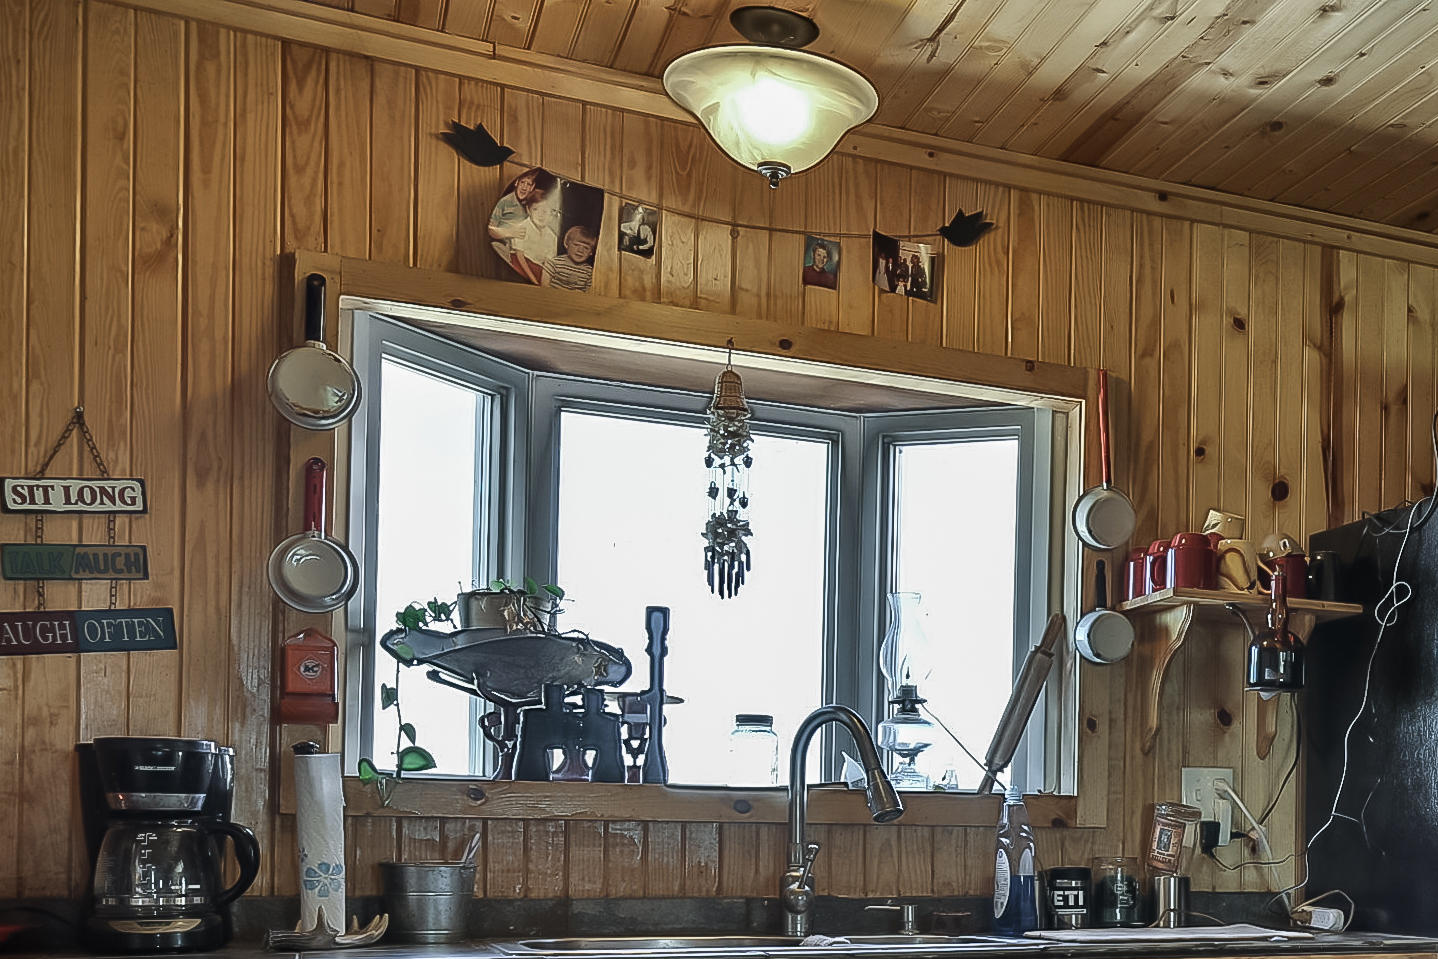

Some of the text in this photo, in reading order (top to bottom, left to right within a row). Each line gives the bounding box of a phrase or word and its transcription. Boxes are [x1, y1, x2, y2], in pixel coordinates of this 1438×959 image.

[11, 484, 138, 507] SIT LONG
[9, 551, 142, 575] TALK MUCH
[0, 617, 165, 645] AUGH OFTEN
[1051, 890, 1084, 906] ETI
